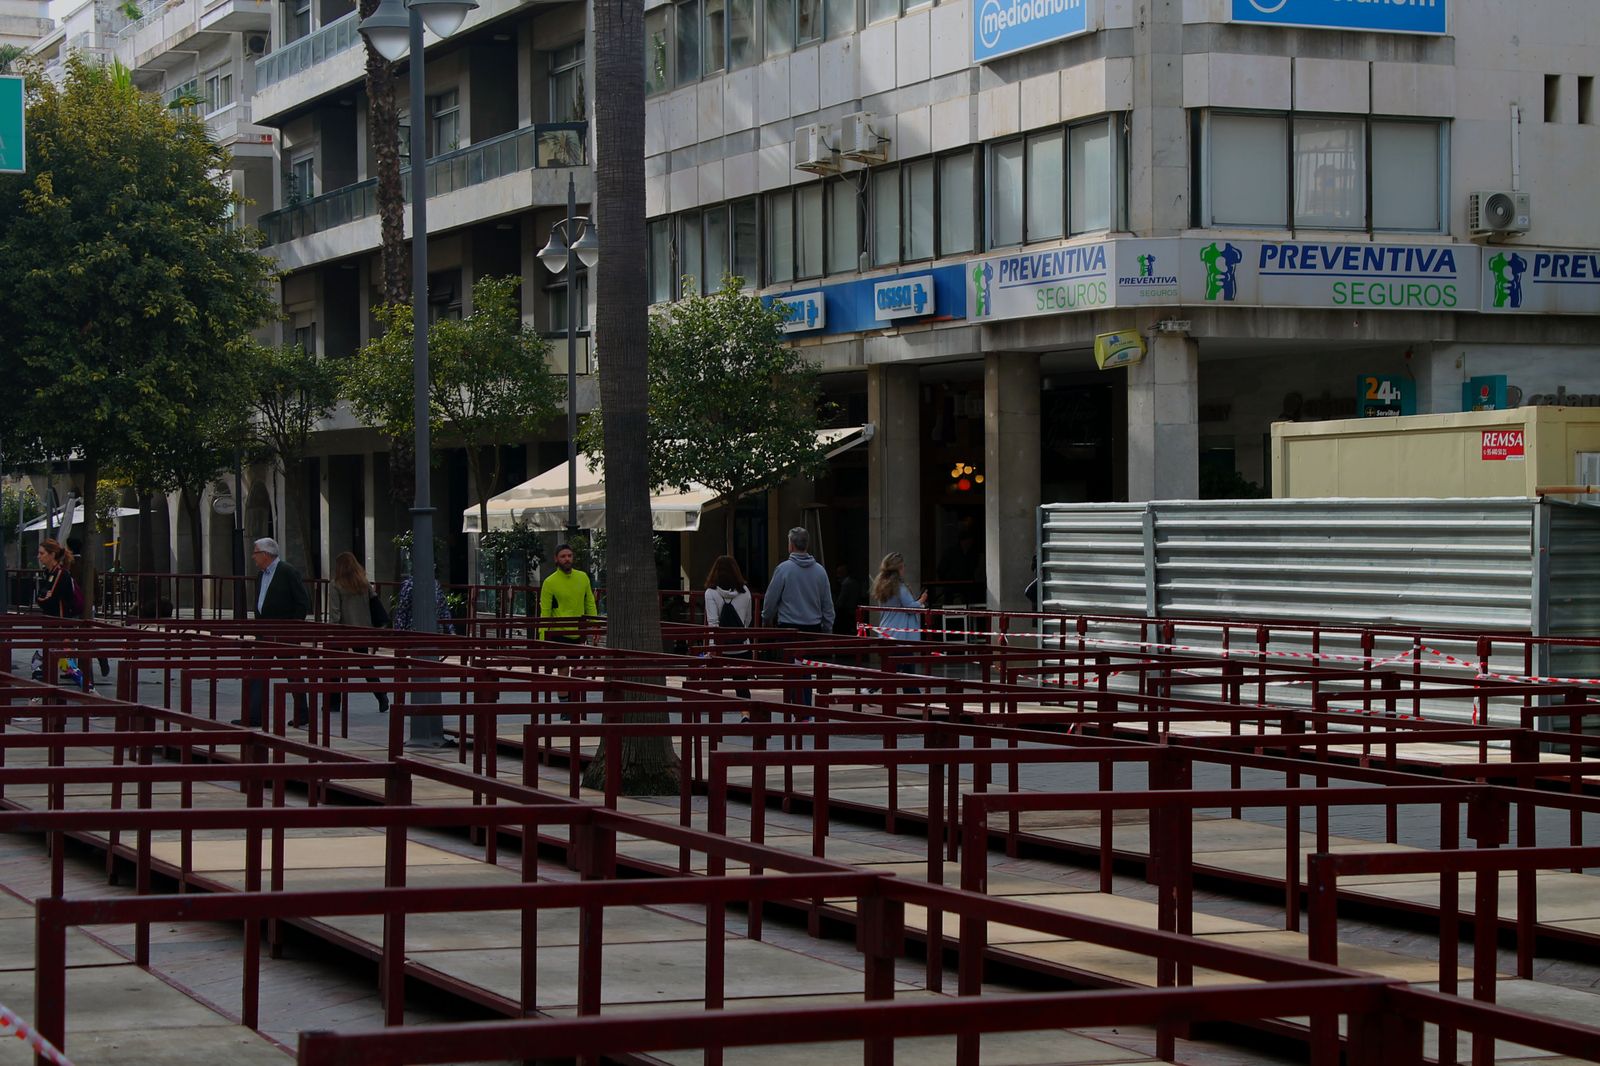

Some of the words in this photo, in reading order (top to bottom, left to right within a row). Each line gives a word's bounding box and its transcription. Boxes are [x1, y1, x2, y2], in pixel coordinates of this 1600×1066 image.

[998, 245, 1107, 283] PREVENTIVA
[1258, 244, 1457, 273] PREVENTIVA
[1119, 276, 1178, 285] PREVENTIVA
[1139, 289, 1178, 297] SEGUROS
[877, 285, 912, 310] asisa
[1036, 281, 1107, 311] SEGUROS
[1332, 281, 1457, 308] SEGUROS
[1366, 376, 1401, 405] 24h
[1483, 432, 1523, 447] REMSA
